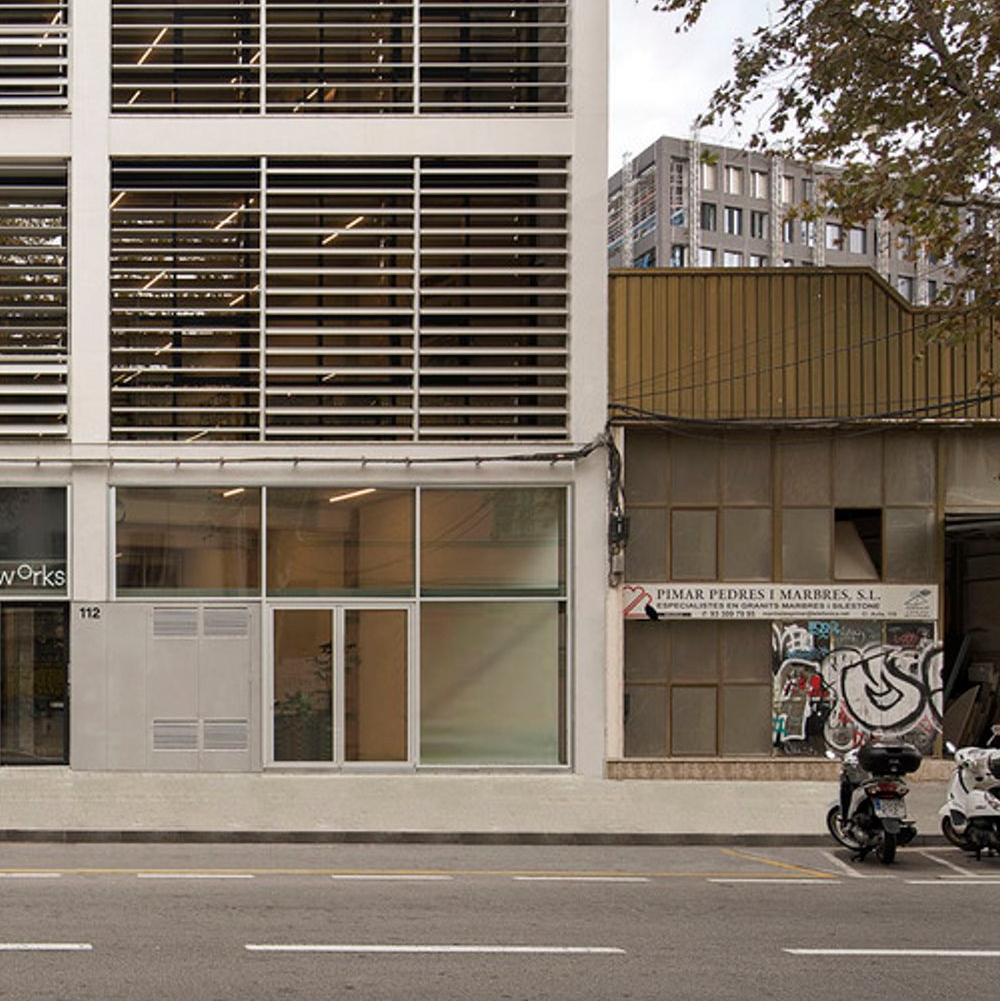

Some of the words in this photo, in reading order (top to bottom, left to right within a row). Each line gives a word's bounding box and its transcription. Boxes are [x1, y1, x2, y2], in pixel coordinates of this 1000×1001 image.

[657, 588, 705, 600] PIMAR
[709, 588, 765, 600] PEDRES
[769, 588, 774, 600] I
[779, 588, 852, 602] MARBRES,
[856, 589, 881, 601] S.L.
[79, 606, 101, 619] 112
[656, 602, 725, 610] ESPECIALISTES
[726, 602, 739, 610] EN
[740, 602, 779, 610] GRANITS
[781, 602, 825, 610] MARBRES
[831, 602, 880, 610] SILESTONE
